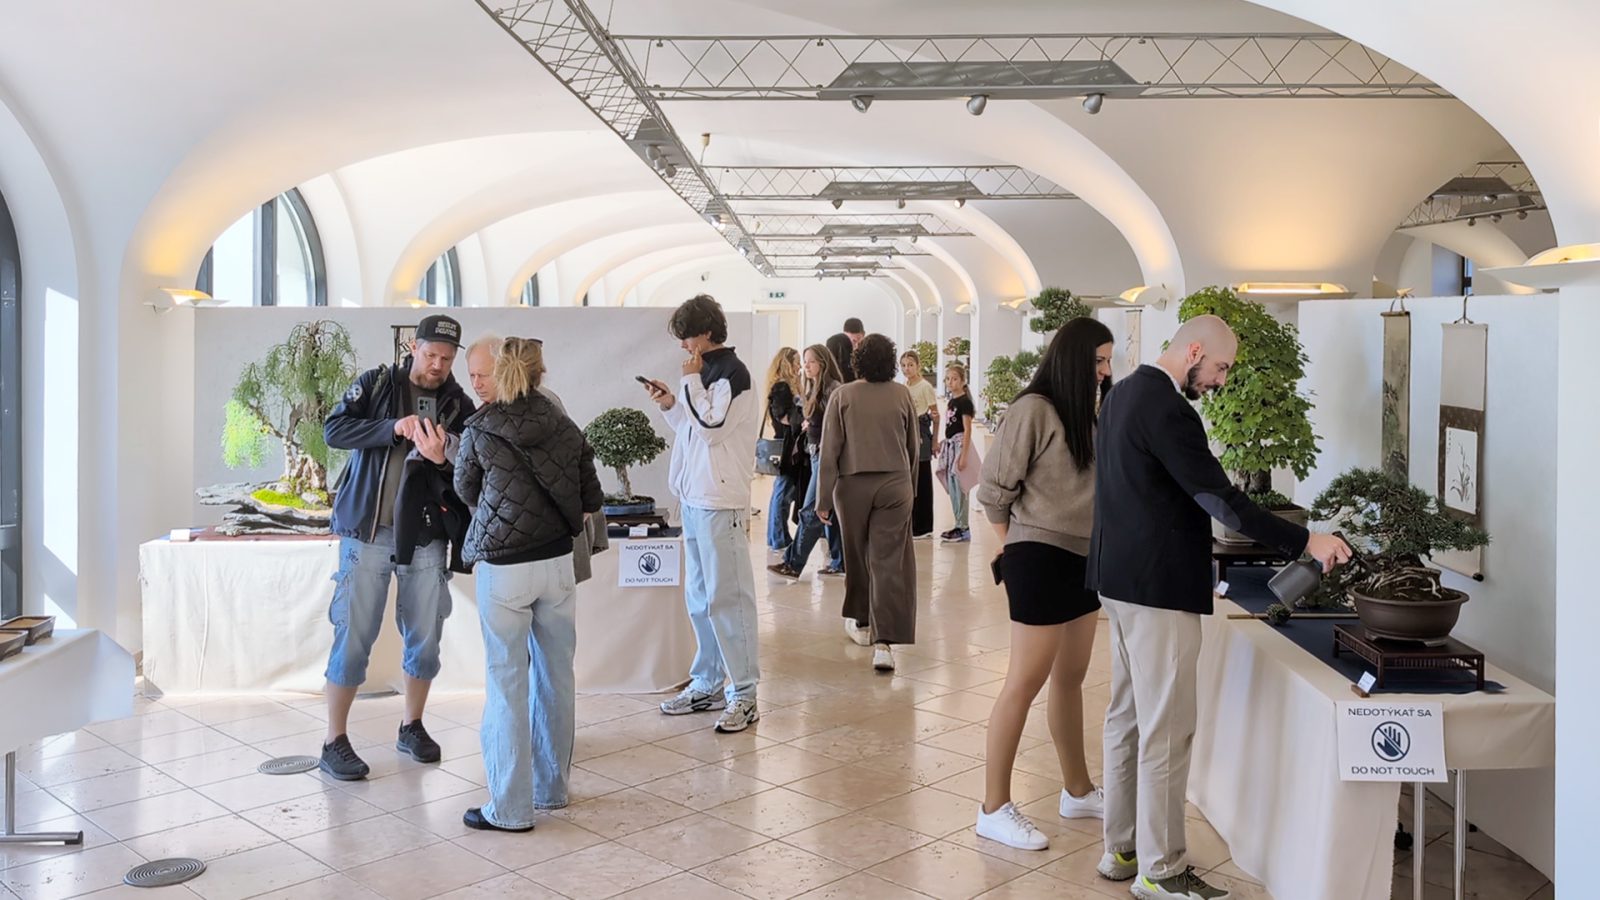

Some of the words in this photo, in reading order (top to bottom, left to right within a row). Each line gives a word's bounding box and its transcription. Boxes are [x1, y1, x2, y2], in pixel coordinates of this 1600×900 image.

[1348, 707, 1415, 717] NEDOTÝKAŤ
[1417, 709, 1432, 717] SA
[1351, 766, 1368, 775] DO
[1370, 766, 1393, 775] NOT
[1395, 767, 1435, 776] TOUCH
